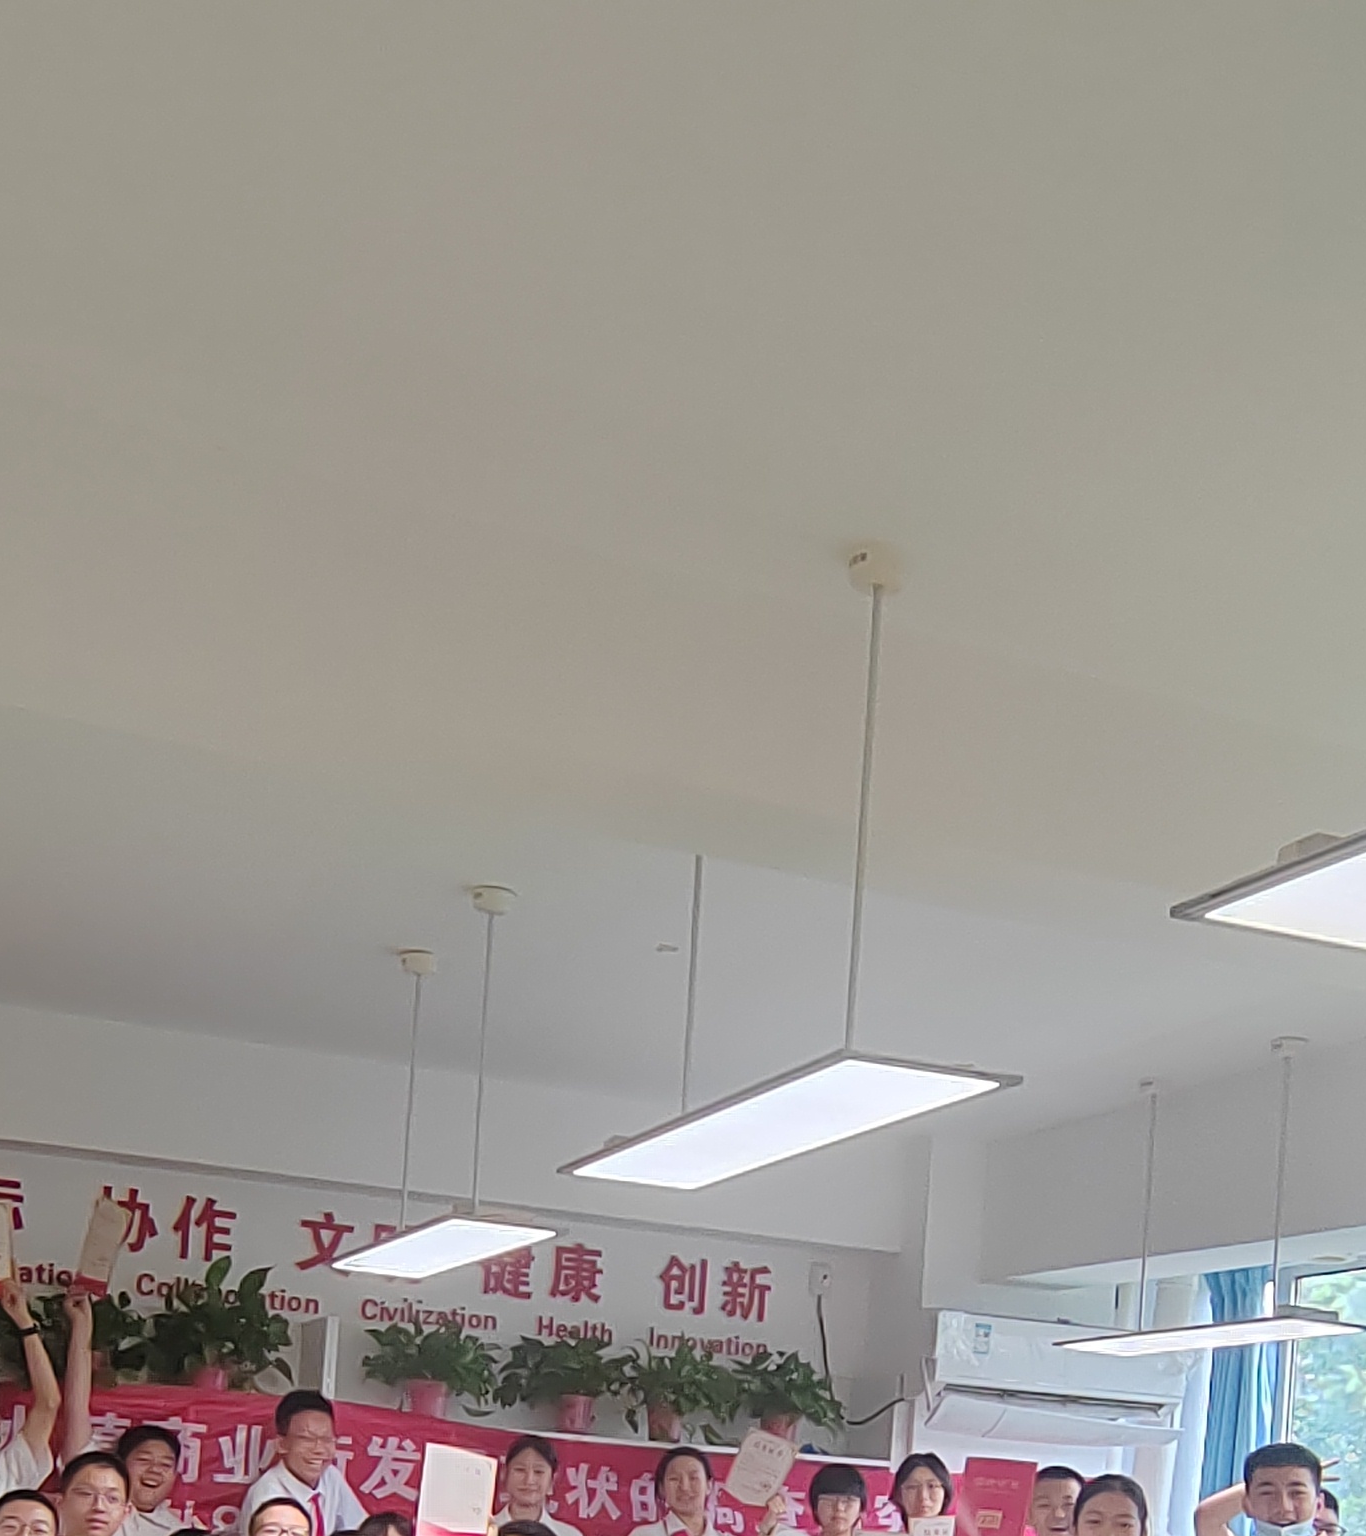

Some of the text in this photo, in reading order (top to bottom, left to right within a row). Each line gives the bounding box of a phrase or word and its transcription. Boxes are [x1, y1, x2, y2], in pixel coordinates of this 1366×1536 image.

[480, 1243, 604, 1303] 健康
[658, 1254, 772, 1323] 创新
[537, 1314, 613, 1343] Health
